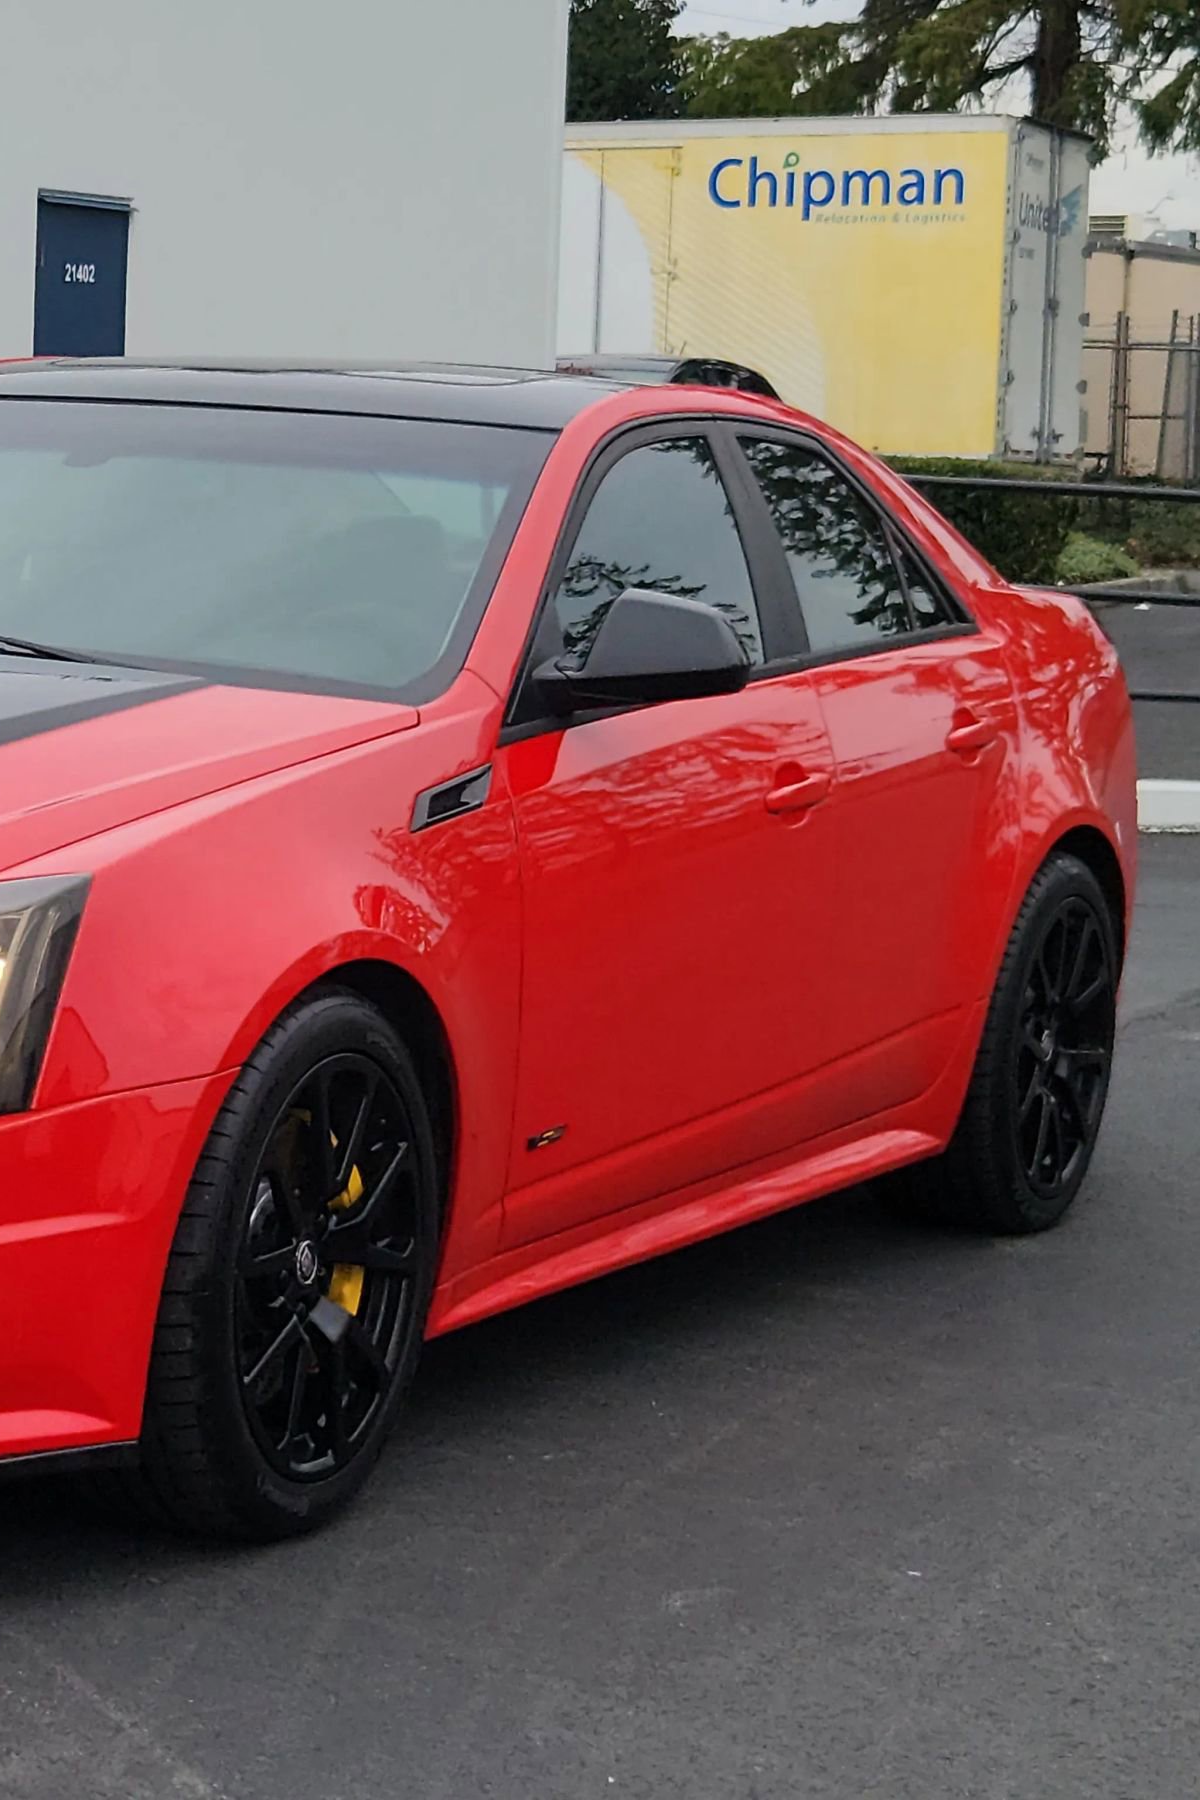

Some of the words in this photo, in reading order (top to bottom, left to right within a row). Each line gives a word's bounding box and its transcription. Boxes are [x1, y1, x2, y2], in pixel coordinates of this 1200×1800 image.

[708, 152, 965, 221] Chipman
[904, 211, 966, 225] Logistics
[64, 263, 95, 283] 21402
